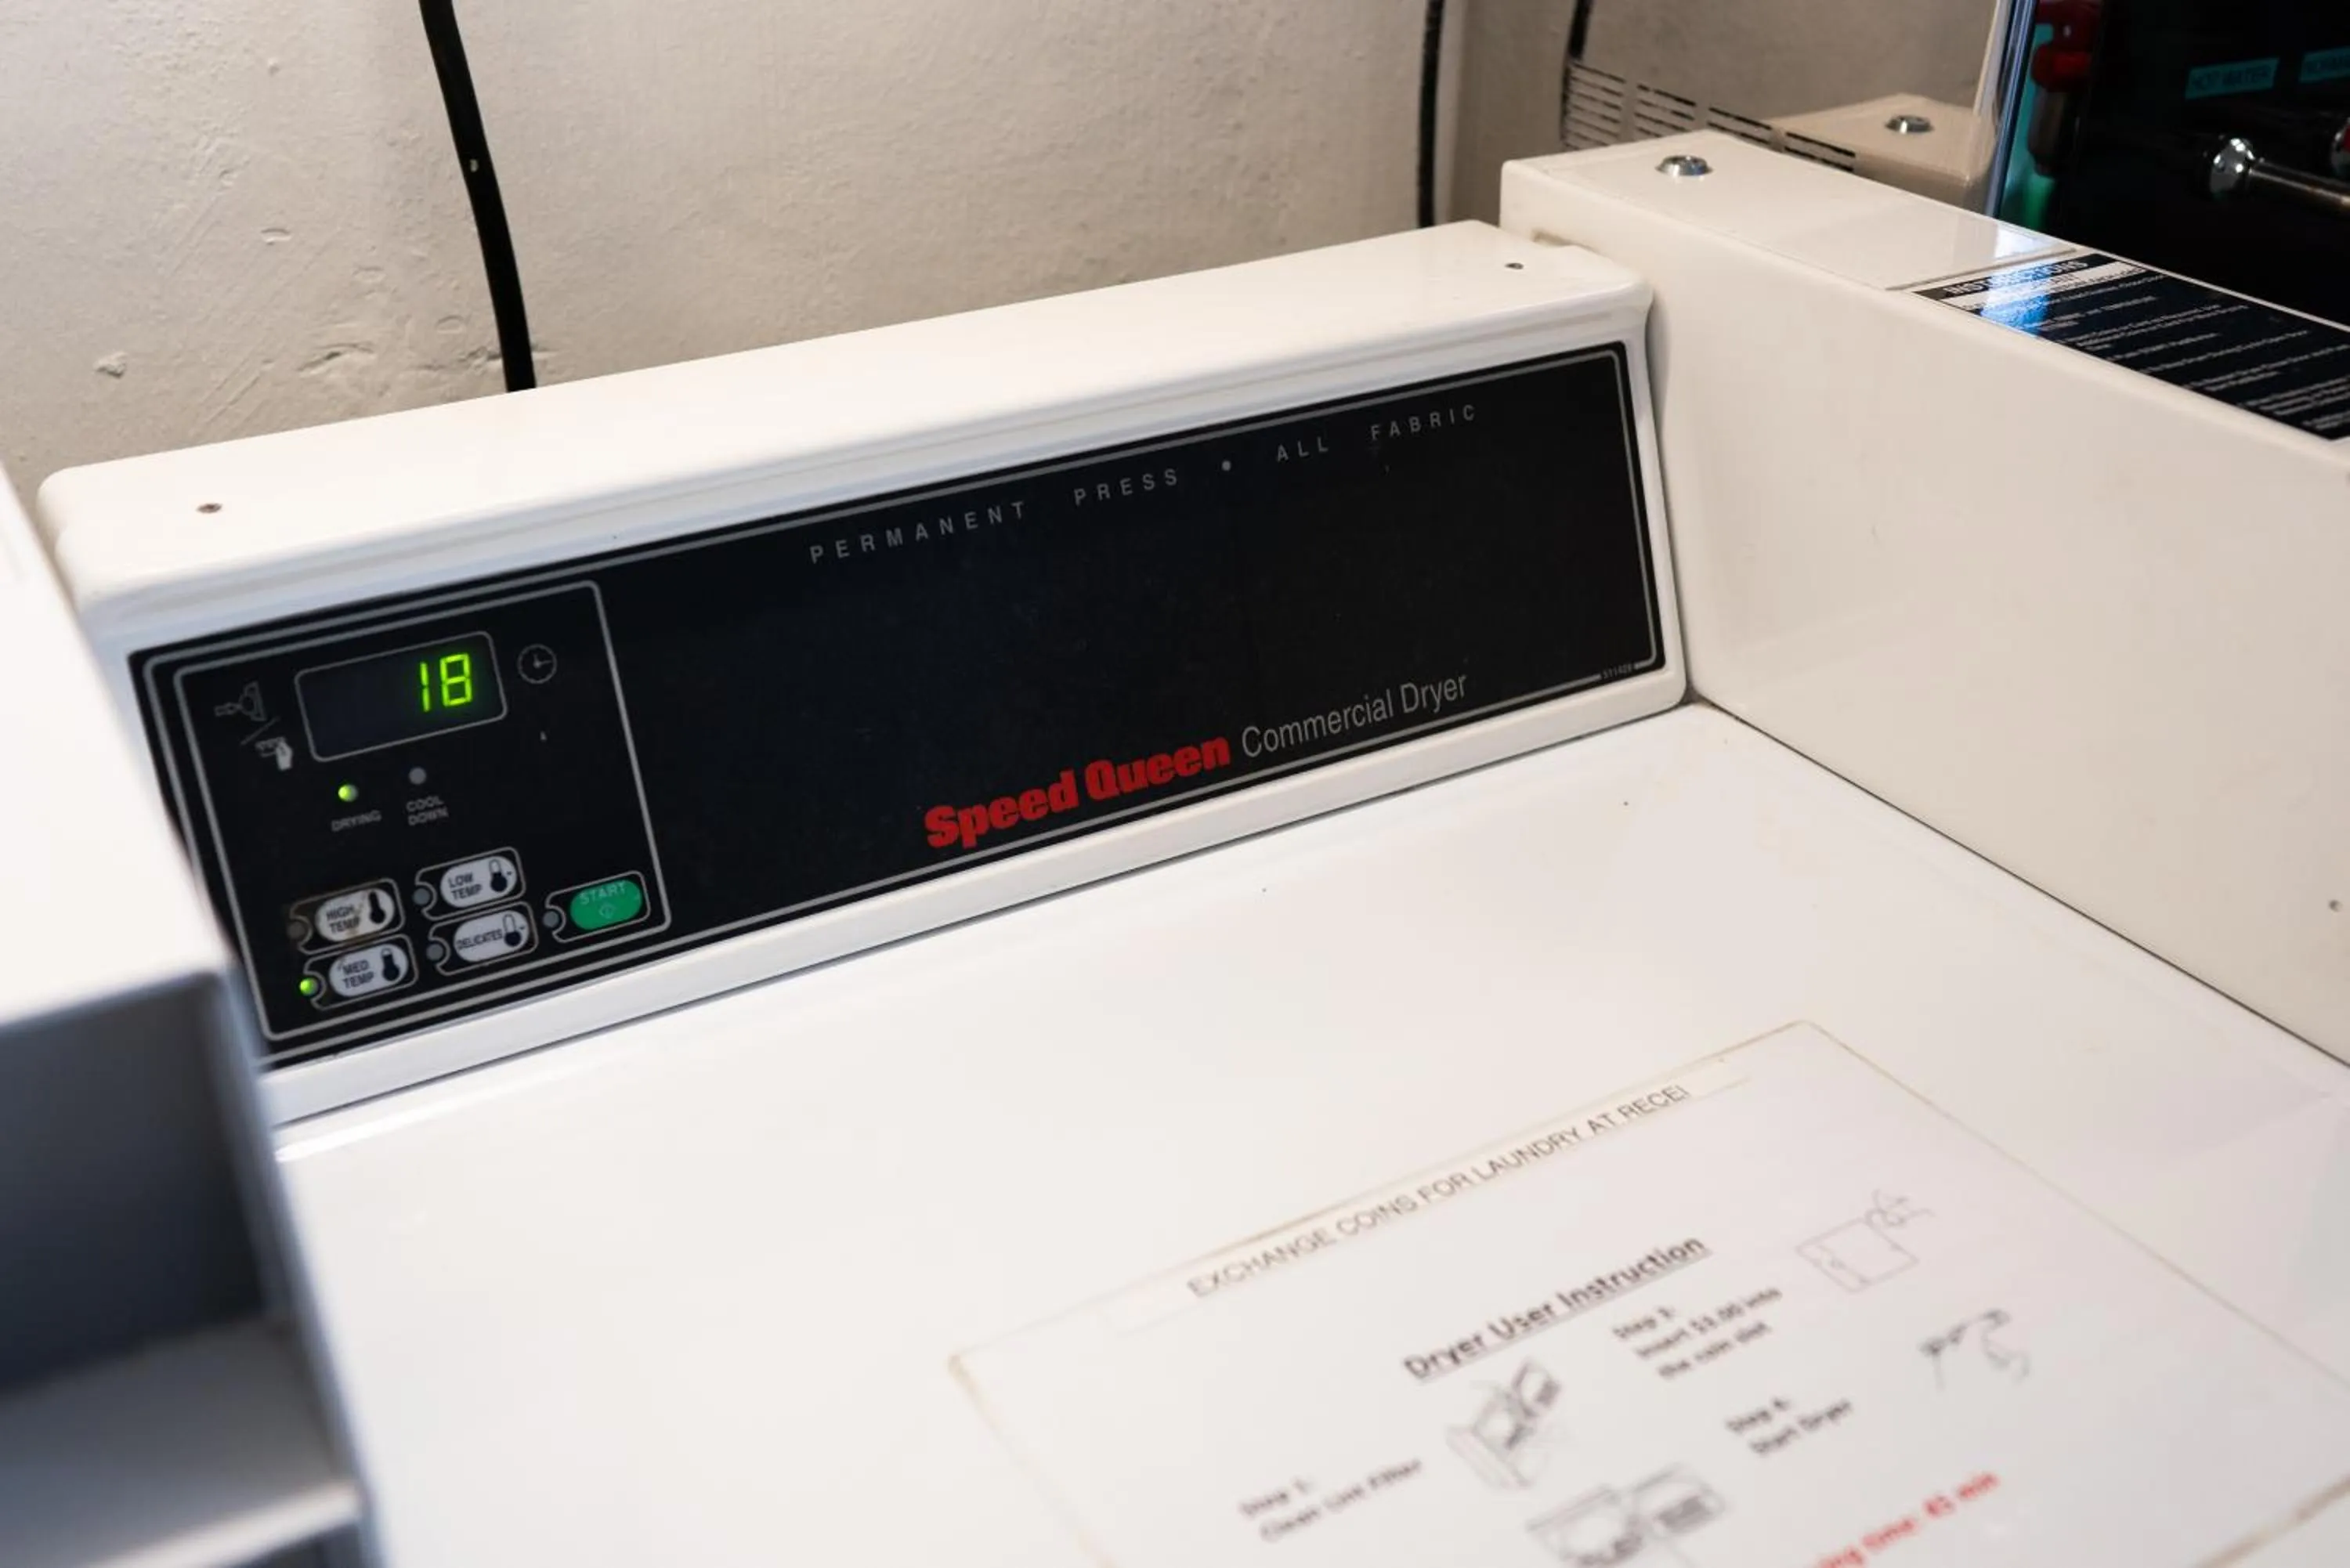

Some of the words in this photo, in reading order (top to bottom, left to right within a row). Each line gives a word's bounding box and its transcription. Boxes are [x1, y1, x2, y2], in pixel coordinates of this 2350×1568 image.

[810, 500, 1025, 564] PERMANENT
[1073, 468, 1179, 506] PRESS
[1276, 436, 1329, 464] ALL
[1370, 404, 1476, 441] FABRIC
[418, 652, 474, 713] 18
[1242, 695, 1394, 760] Commercial
[1399, 675, 1468, 716] Dryer
[406, 796, 444, 812] COOL
[924, 771, 1079, 851] Speed
[1084, 735, 1232, 802] Queen
[331, 809, 382, 832] DRYING
[408, 806, 449, 826] DOWN
[447, 873, 474, 889] LOW
[451, 883, 483, 901] TEMP
[580, 881, 626, 905] START
[326, 905, 354, 921] HIGH
[329, 916, 361, 934] TEMP
[457, 928, 503, 950] DELICATES
[342, 960, 369, 976] MED
[343, 971, 374, 989] TEMP
[1187, 1226, 1336, 1299] EXCHANGE
[1335, 1194, 1419, 1237] COINS
[1417, 1172, 1473, 1207] FOR
[1473, 1125, 1584, 1182] LAUNDRY
[1585, 1111, 1618, 1137] AT
[1402, 1329, 1488, 1381] Dryer
[1487, 1300, 1557, 1342] User
[1556, 1235, 1706, 1311] Instruction
